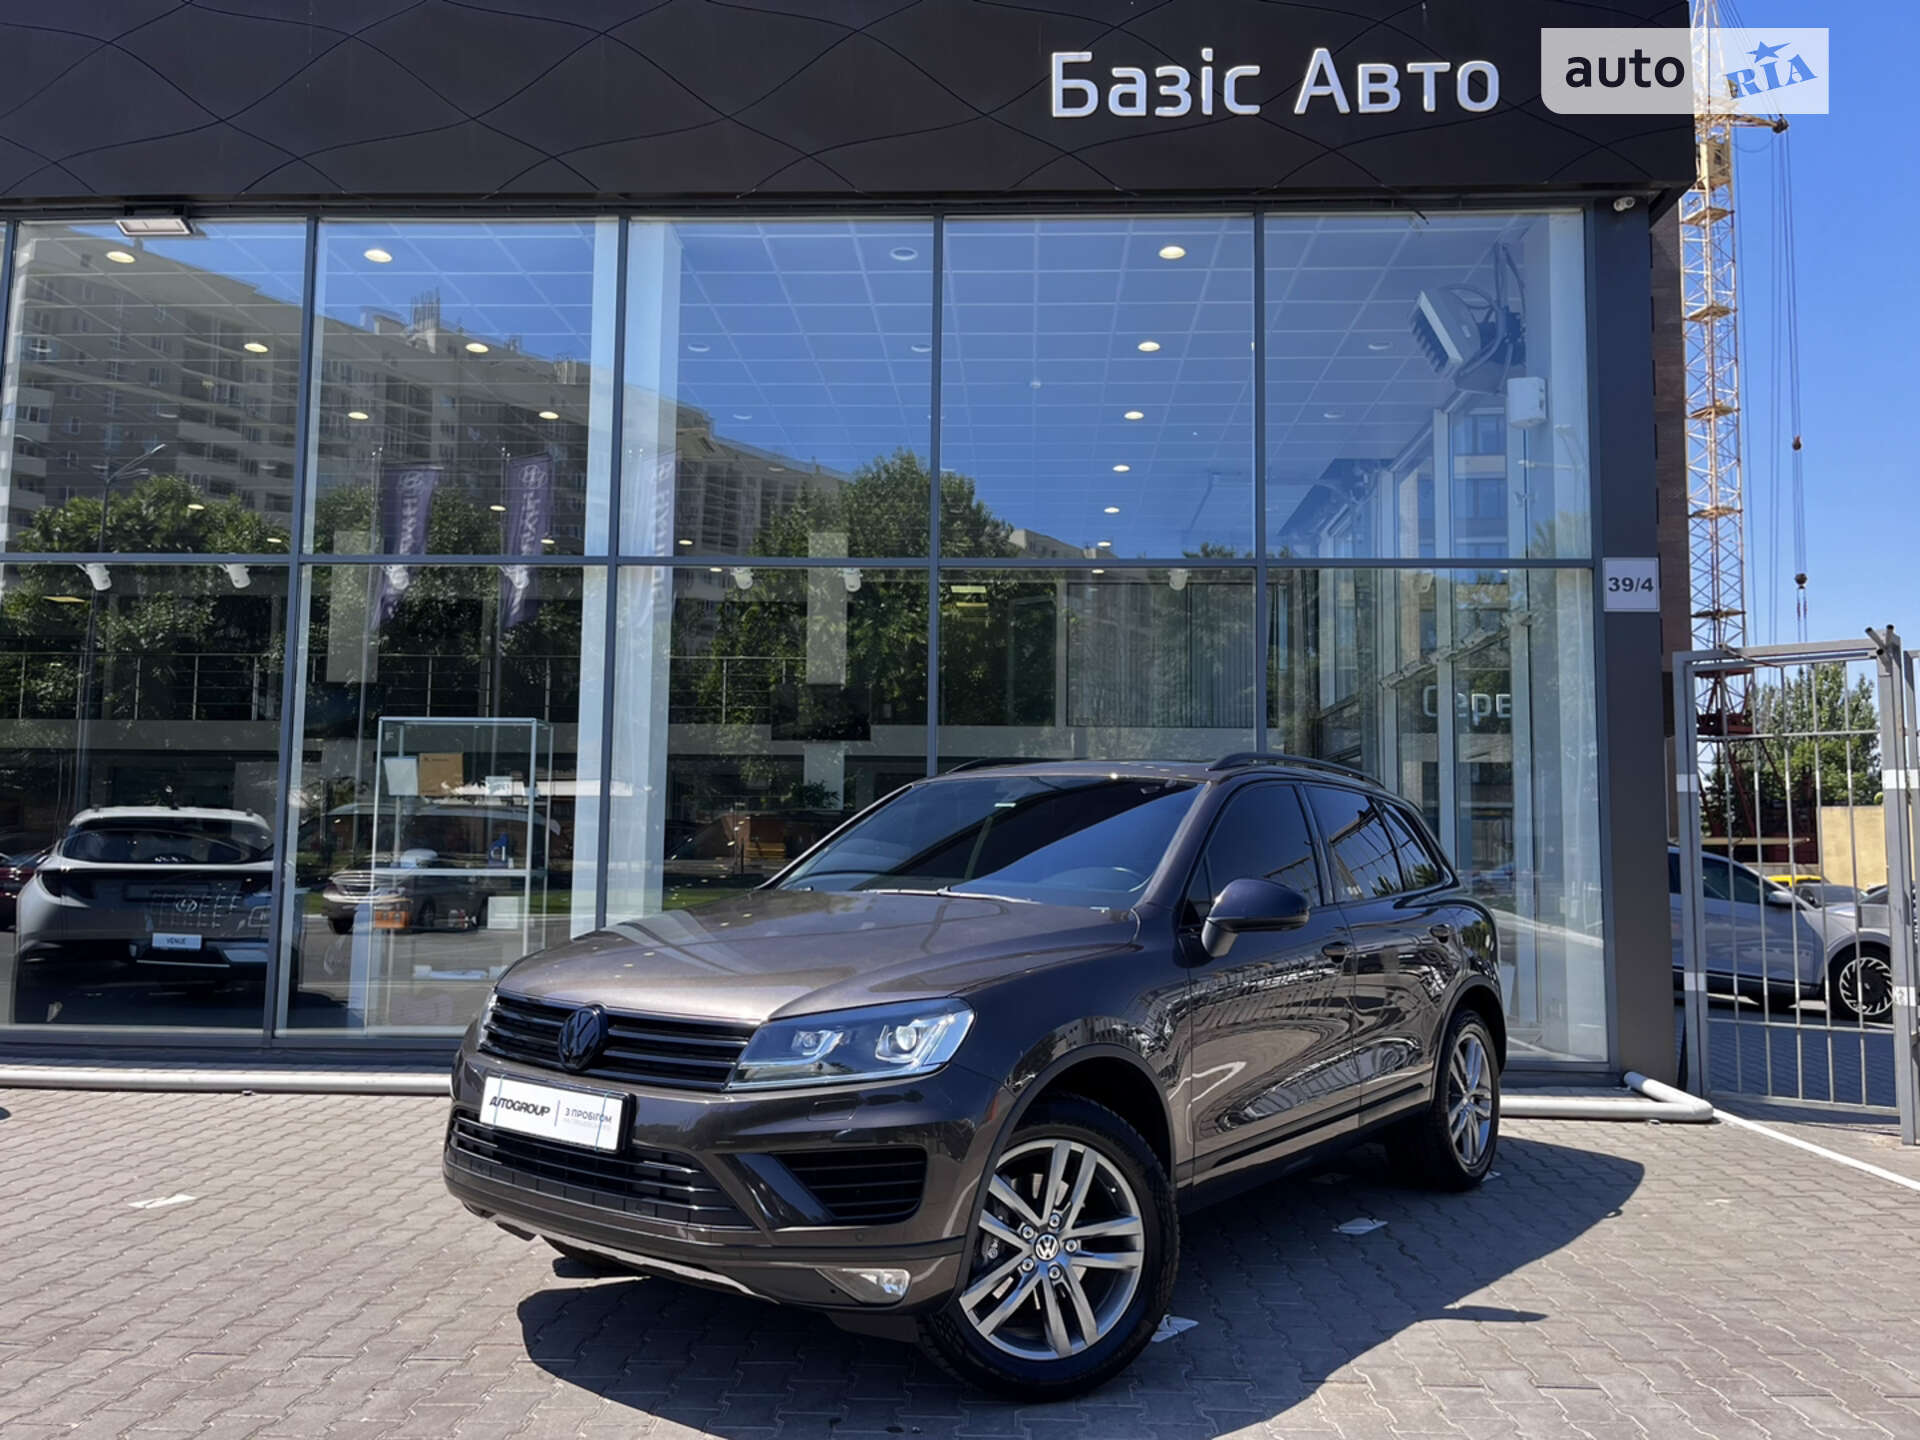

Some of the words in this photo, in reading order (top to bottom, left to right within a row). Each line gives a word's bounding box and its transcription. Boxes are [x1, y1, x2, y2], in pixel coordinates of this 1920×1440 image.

[1052, 47, 1261, 118] Базіс
[1294, 47, 1500, 115] Авто
[1608, 576, 1654, 593] 39/4
[489, 1096, 551, 1117] AUTOGROUP
